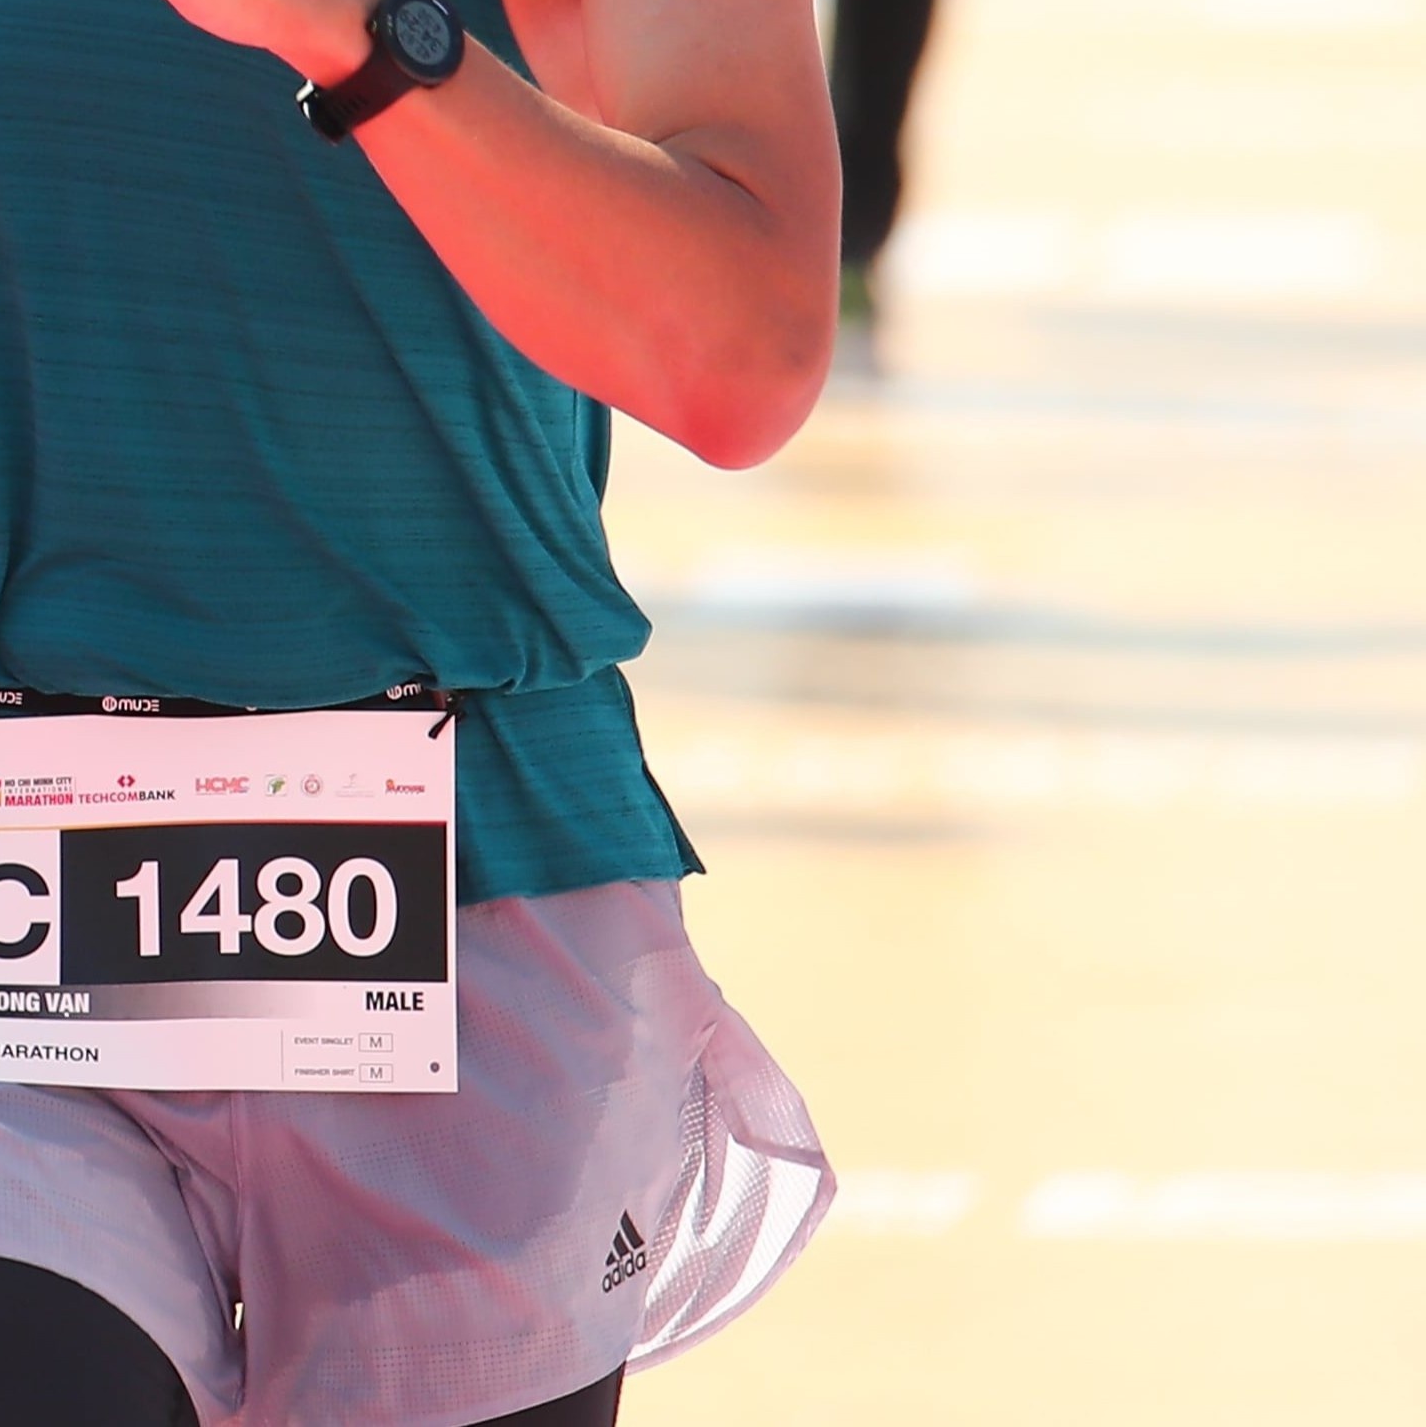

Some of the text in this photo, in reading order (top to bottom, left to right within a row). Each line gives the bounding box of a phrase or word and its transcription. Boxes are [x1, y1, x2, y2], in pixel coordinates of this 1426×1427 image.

[56, 776, 72, 785] CITY
[4, 789, 176, 807] MARATHON TECHCOMBANK
[115, 857, 398, 957] 1480
[365, 990, 425, 1012] MALE
[293, 1037, 354, 1046] EVENT SINGLET
[369, 1036, 383, 1048] M
[369, 1067, 383, 1079] M
